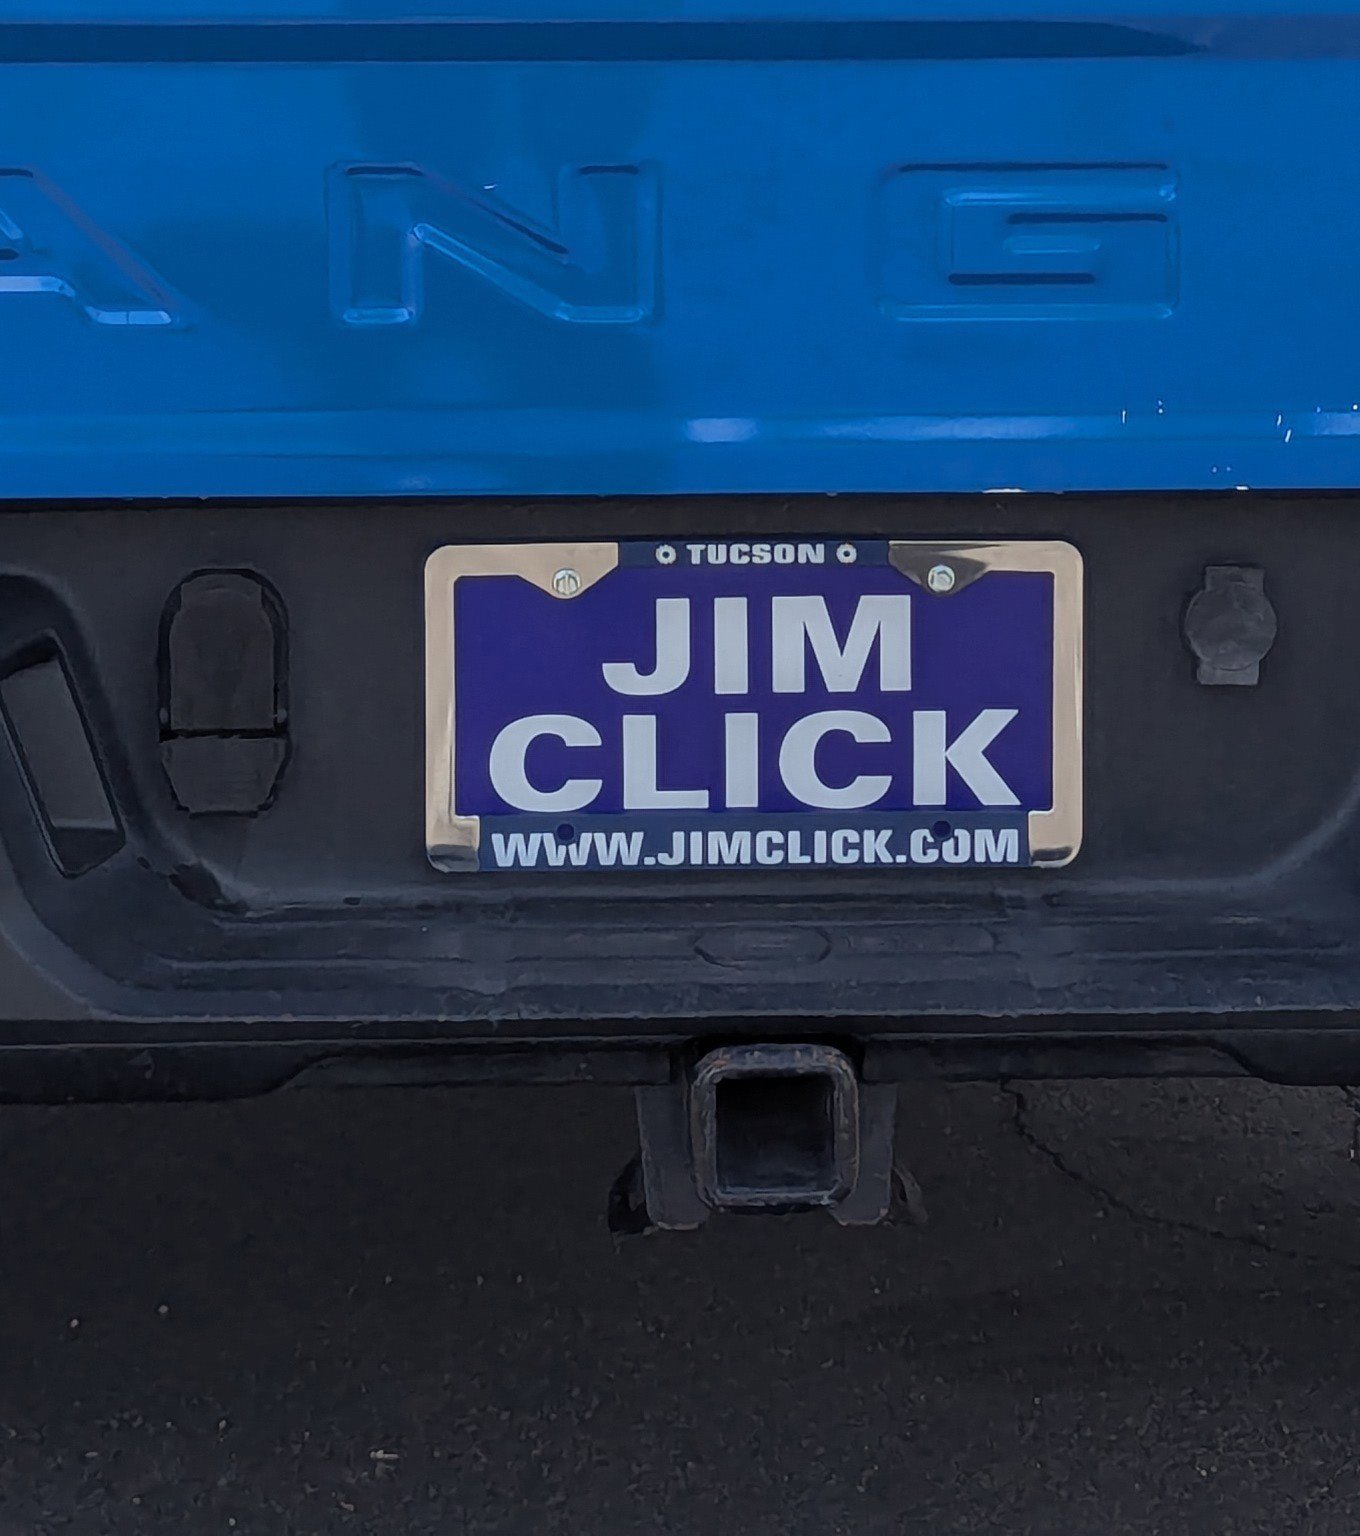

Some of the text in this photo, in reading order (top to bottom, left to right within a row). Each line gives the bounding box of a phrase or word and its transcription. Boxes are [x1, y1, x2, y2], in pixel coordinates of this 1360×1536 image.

[686, 543, 825, 565] TUCSON
[601, 594, 913, 696] JIM
[489, 707, 1023, 813] CLICK
[491, 828, 1020, 868] WWW.JIMCLICK.COM
